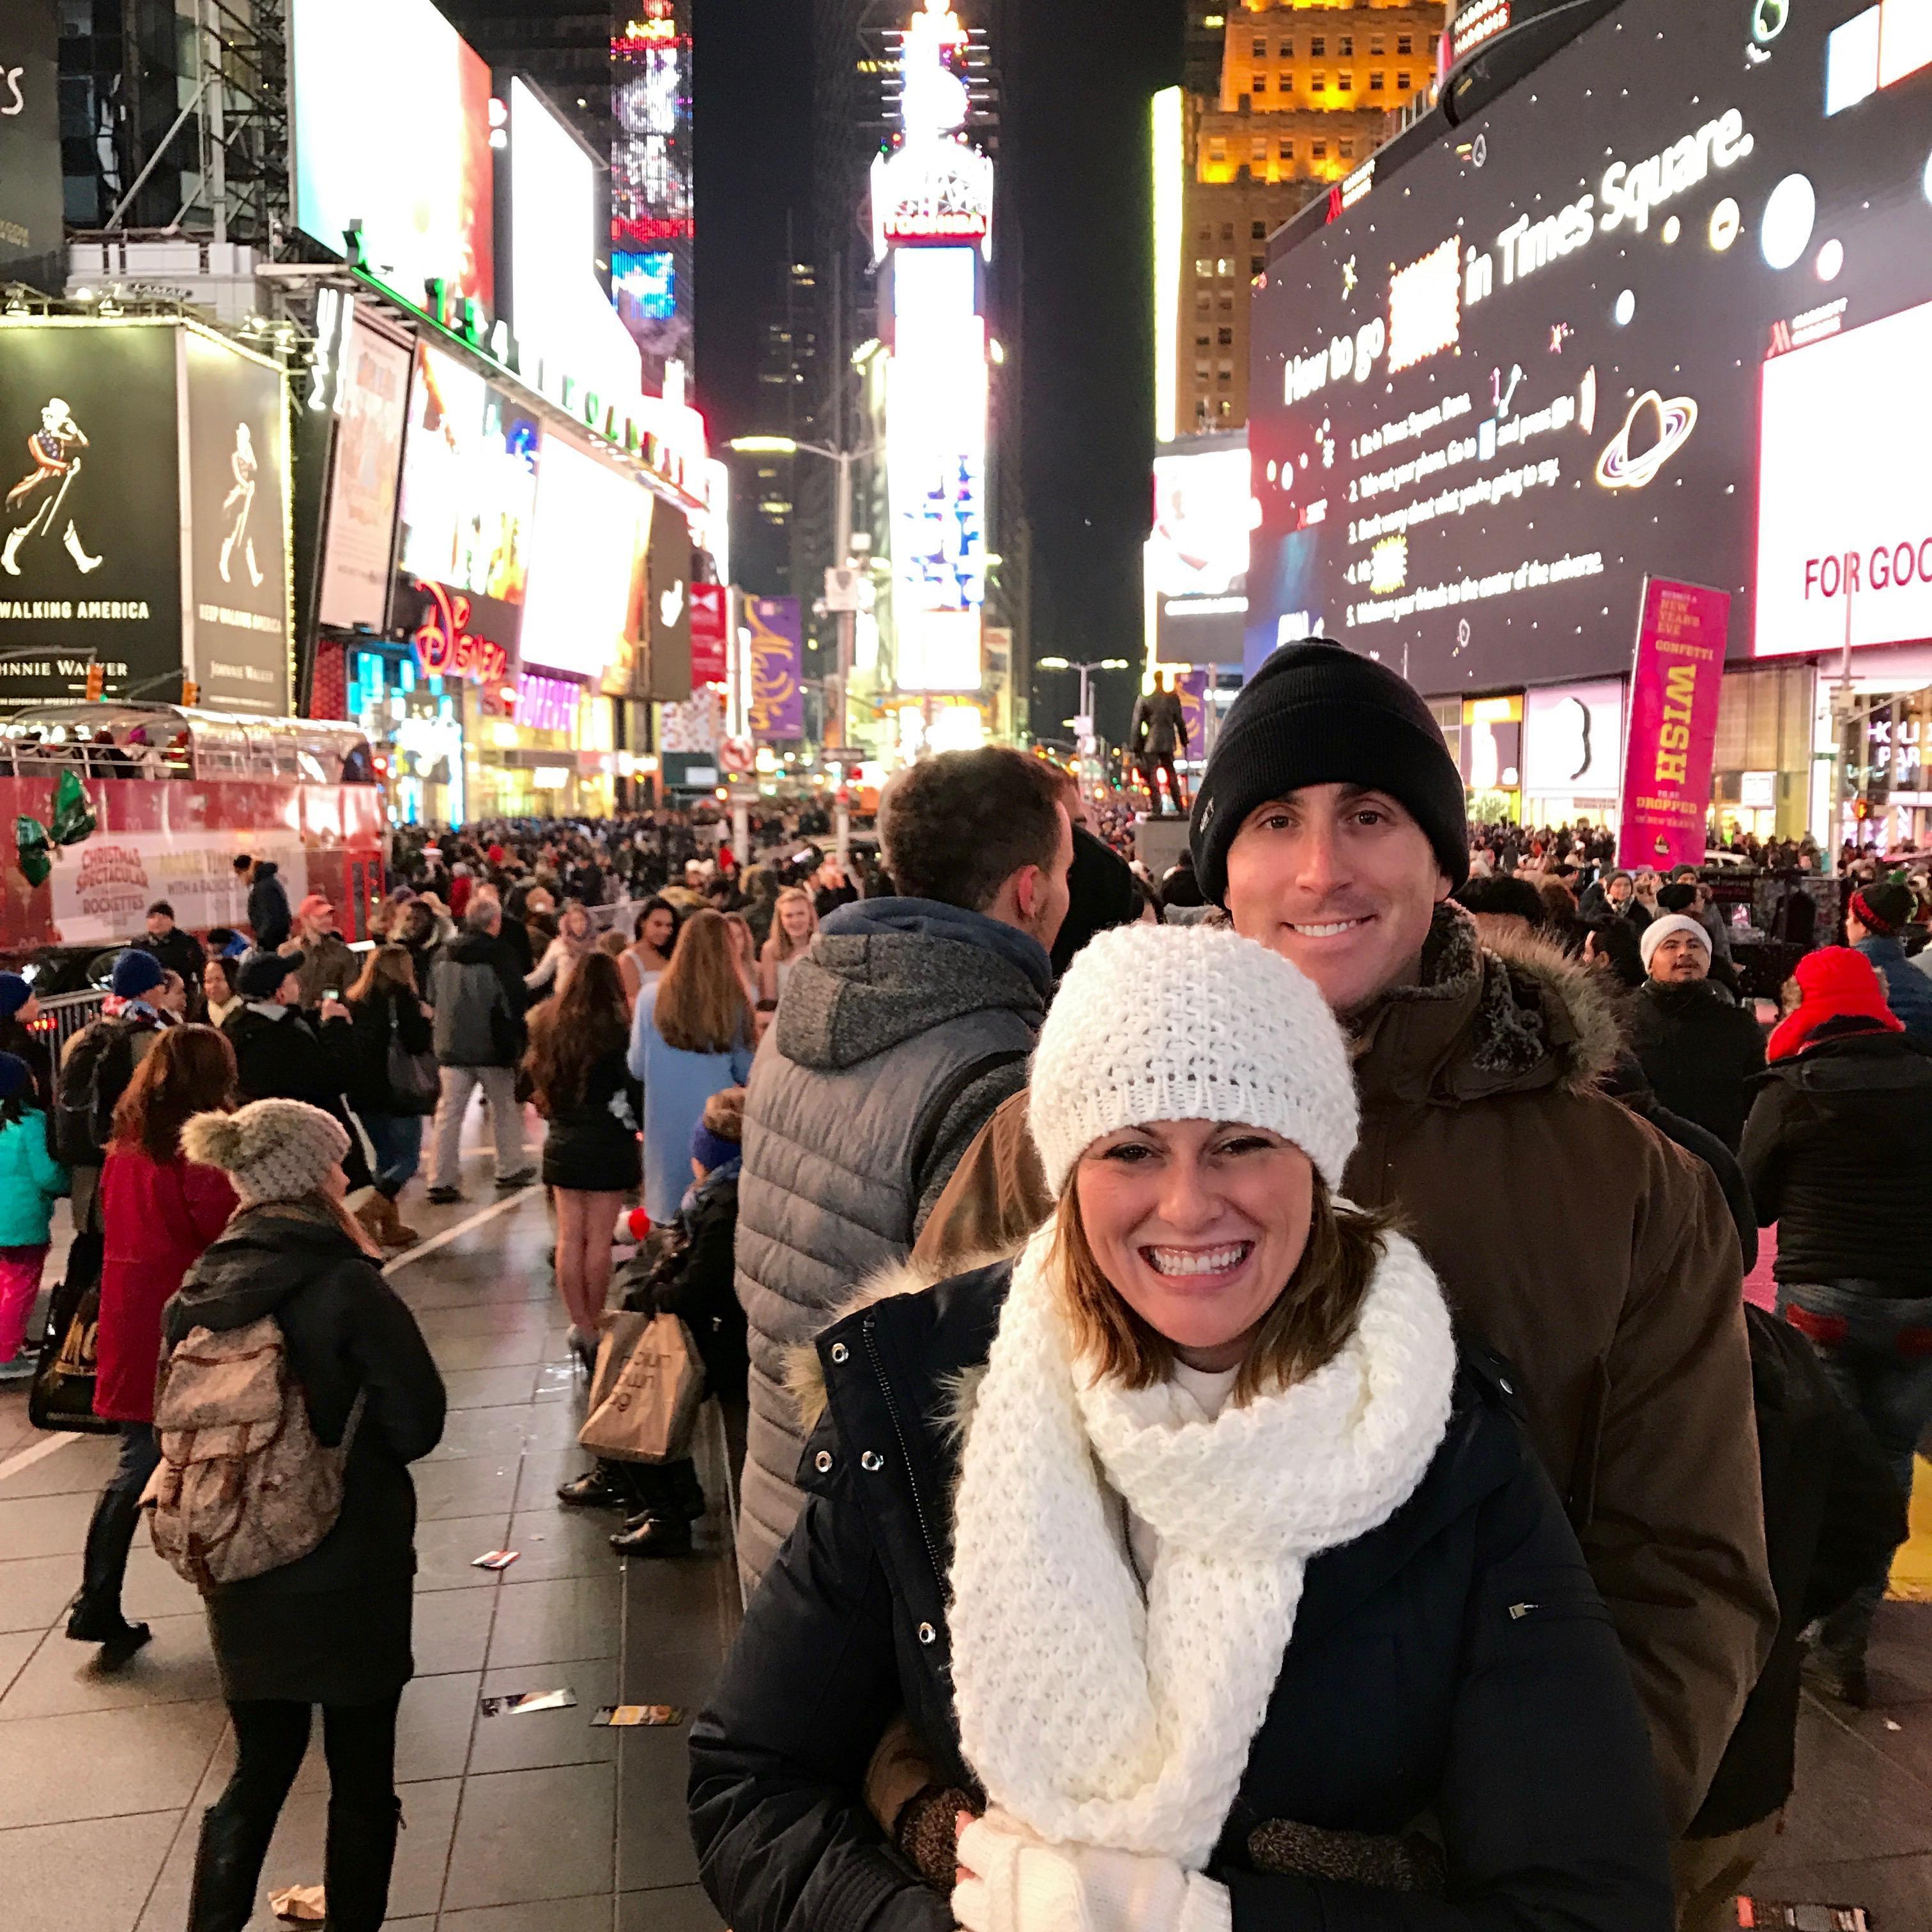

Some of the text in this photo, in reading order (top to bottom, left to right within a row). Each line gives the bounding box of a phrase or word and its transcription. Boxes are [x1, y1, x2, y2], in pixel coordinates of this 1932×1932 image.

[1454, 0, 1505, 35] MARRIO
[1453, 7, 1508, 57] MARQUIS
[884, 213, 986, 234] TOSHIBA
[1285, 108, 1754, 405] How to go in Times Square.
[1448, 440, 1464, 465] Go
[1497, 414, 1520, 446] and
[1523, 464, 1537, 487] to
[1805, 551, 1860, 600] FOR
[0, 601, 150, 619] WALKING AMERICA
[1660, 599, 1689, 612] NEW
[1657, 622, 1681, 636] EVE
[1655, 639, 1713, 661] CONFETTI
[56, 659, 128, 677] WAER
[1655, 664, 1697, 784] WISH
[1636, 796, 1697, 815] DROPPED
[83, 894, 145, 914] ROCKETTES
